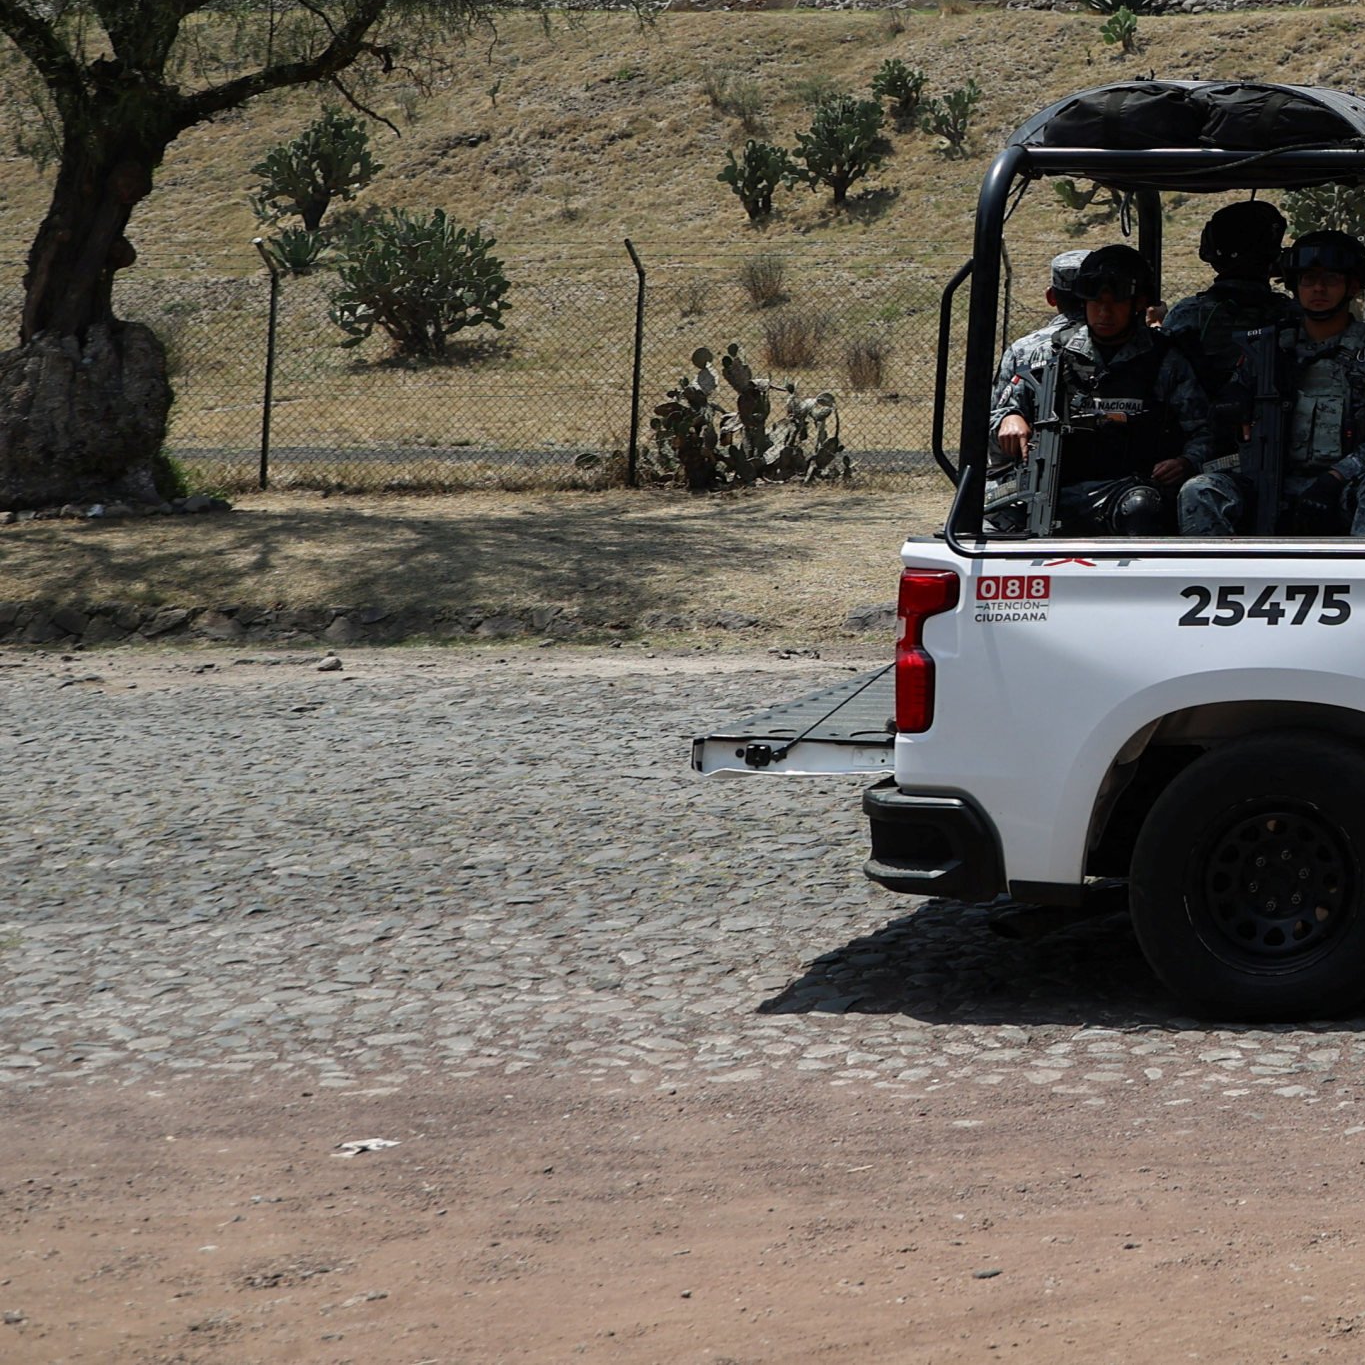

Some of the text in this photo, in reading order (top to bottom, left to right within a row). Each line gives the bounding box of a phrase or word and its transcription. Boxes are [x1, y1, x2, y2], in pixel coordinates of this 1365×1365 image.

[981, 579, 1045, 598] 088
[983, 600, 1041, 610] ATENCIÓN
[1178, 585, 1351, 627] 25475
[975, 612, 1047, 623] CIUDADANA
